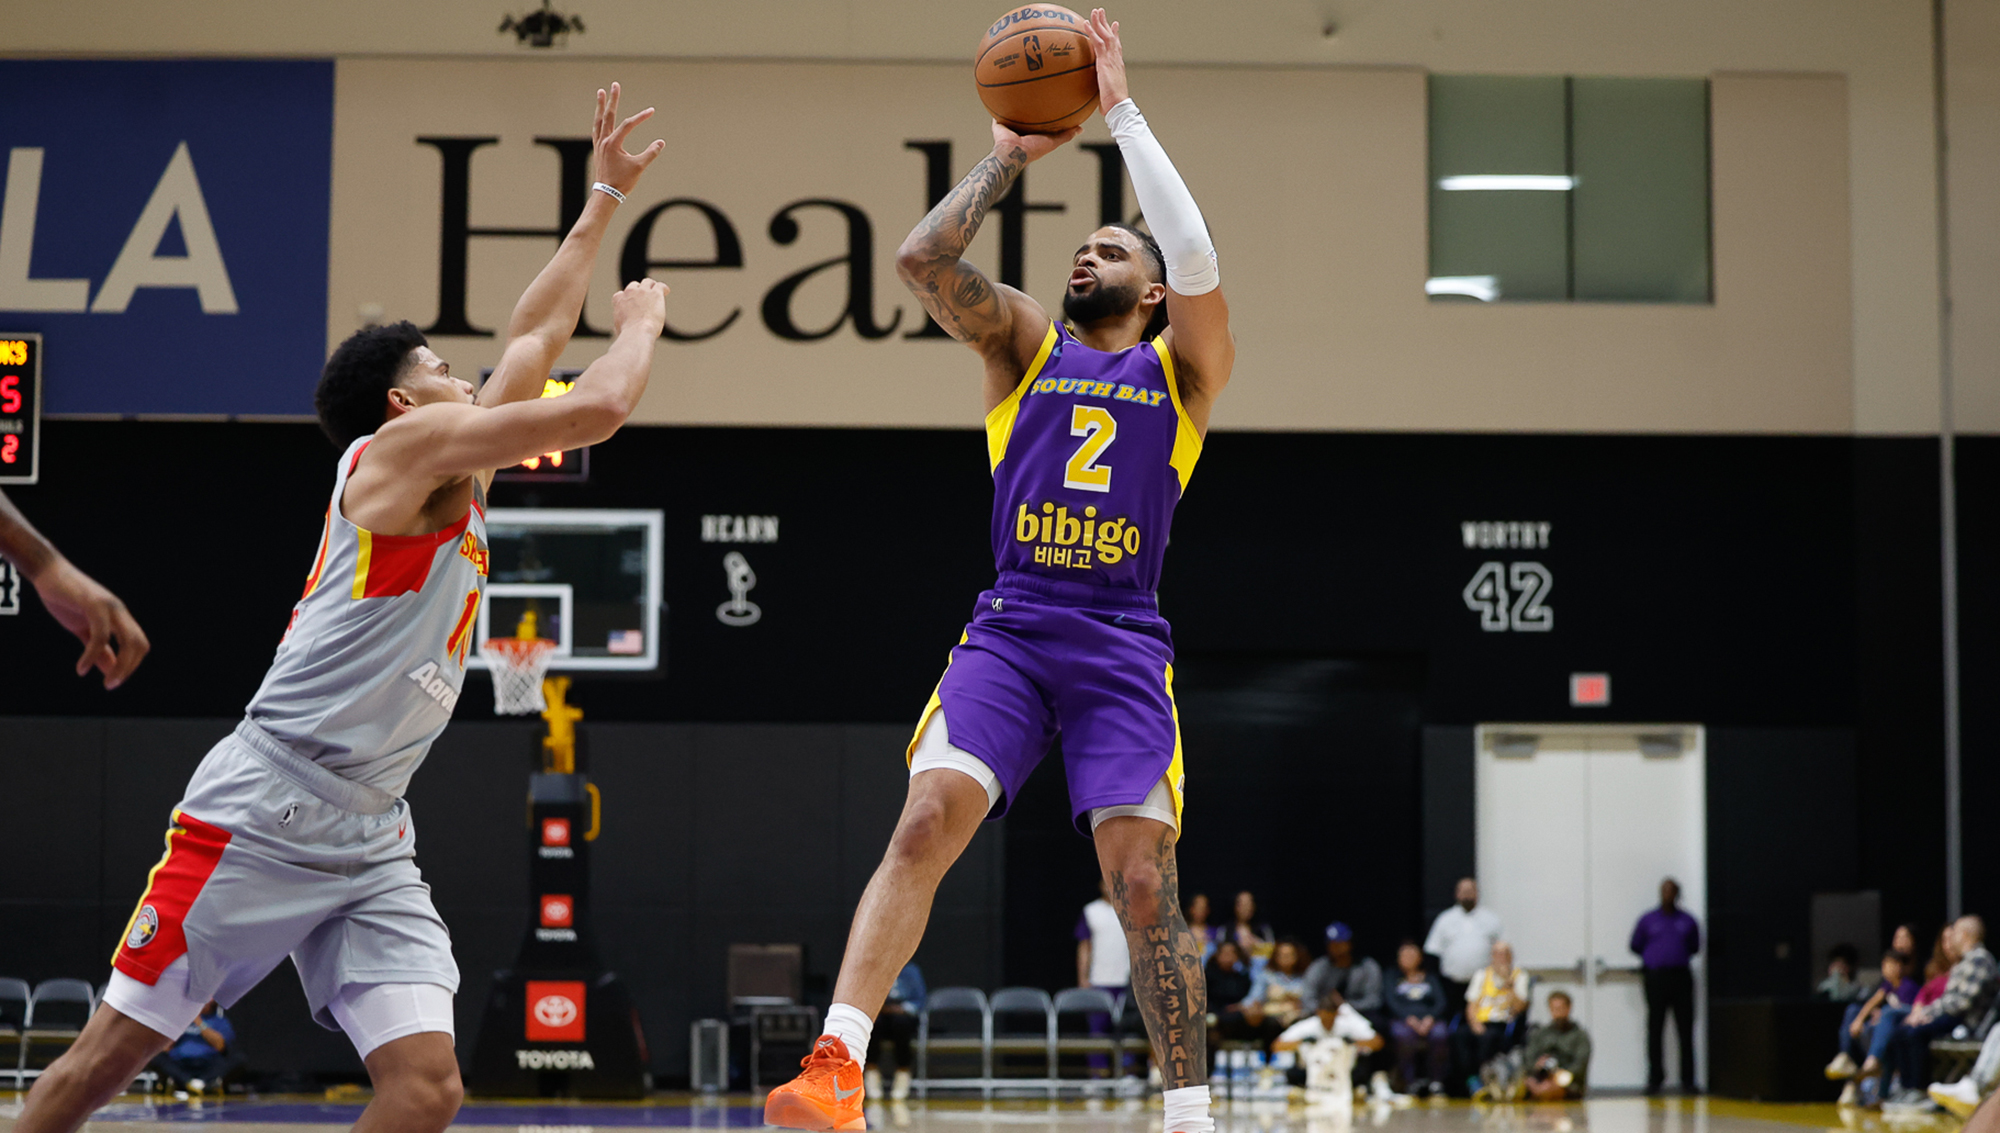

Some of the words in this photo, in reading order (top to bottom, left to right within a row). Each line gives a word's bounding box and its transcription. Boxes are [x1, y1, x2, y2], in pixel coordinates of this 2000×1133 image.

[988, 8, 1075, 38] Wilson
[1030, 377, 1115, 398] SOUTH
[1113, 383, 1168, 407] BAY
[1063, 404, 1118, 493] 2
[1016, 502, 1141, 565] bibigo
[1461, 521, 1551, 549] WORTHY
[1034, 546, 1092, 570] 비비고
[1463, 562, 1553, 632] 42
[446, 587, 480, 672] 1
[1146, 927, 1178, 990] WALK
[515, 1049, 595, 1070] TOYOTA
